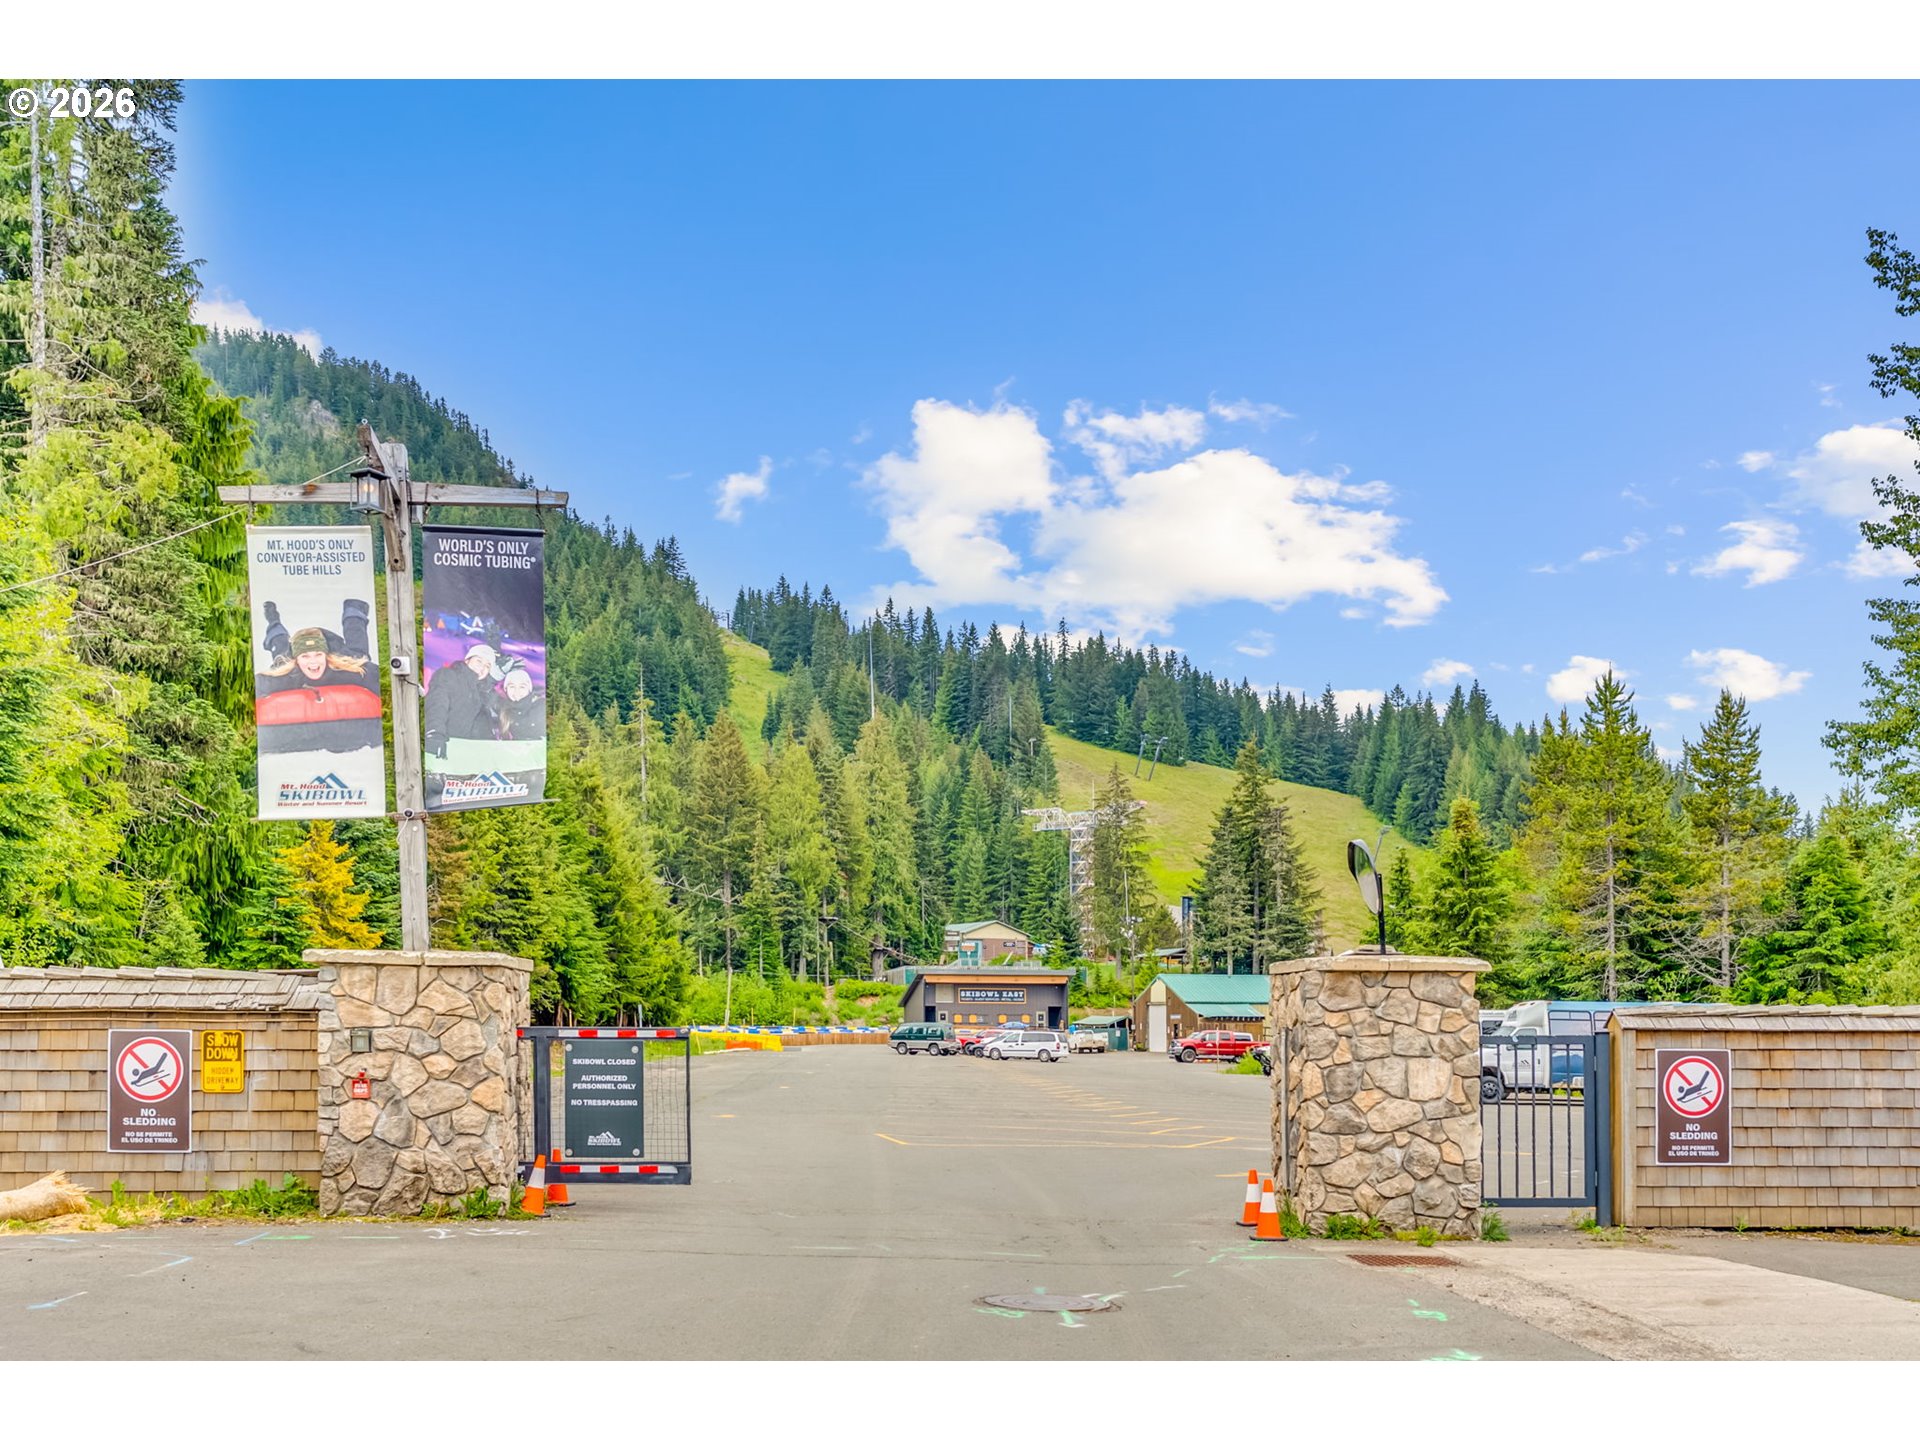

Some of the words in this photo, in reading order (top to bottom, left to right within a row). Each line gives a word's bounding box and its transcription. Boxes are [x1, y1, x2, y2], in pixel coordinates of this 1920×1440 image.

[267, 539, 284, 550] MT.
[287, 539, 326, 550] HOOD'S
[328, 539, 355, 550] ONLY
[438, 538, 495, 554] WORLD'S
[497, 540, 529, 555] ONLY
[257, 552, 365, 563] CONVEYOR-ASSISTED
[433, 553, 482, 567] COSMIC
[282, 564, 310, 576] TUBE
[312, 564, 342, 575] HILLS
[464, 780, 491, 788] Hood
[279, 789, 367, 801] SKIBOWL
[206, 1076, 239, 1085] DRIVEWAY
[140, 1108, 157, 1117] NO
[122, 1117, 177, 1127] SLEDDING
[1686, 1123, 1700, 1131] NO
[1669, 1132, 1718, 1140] SLEDDING
